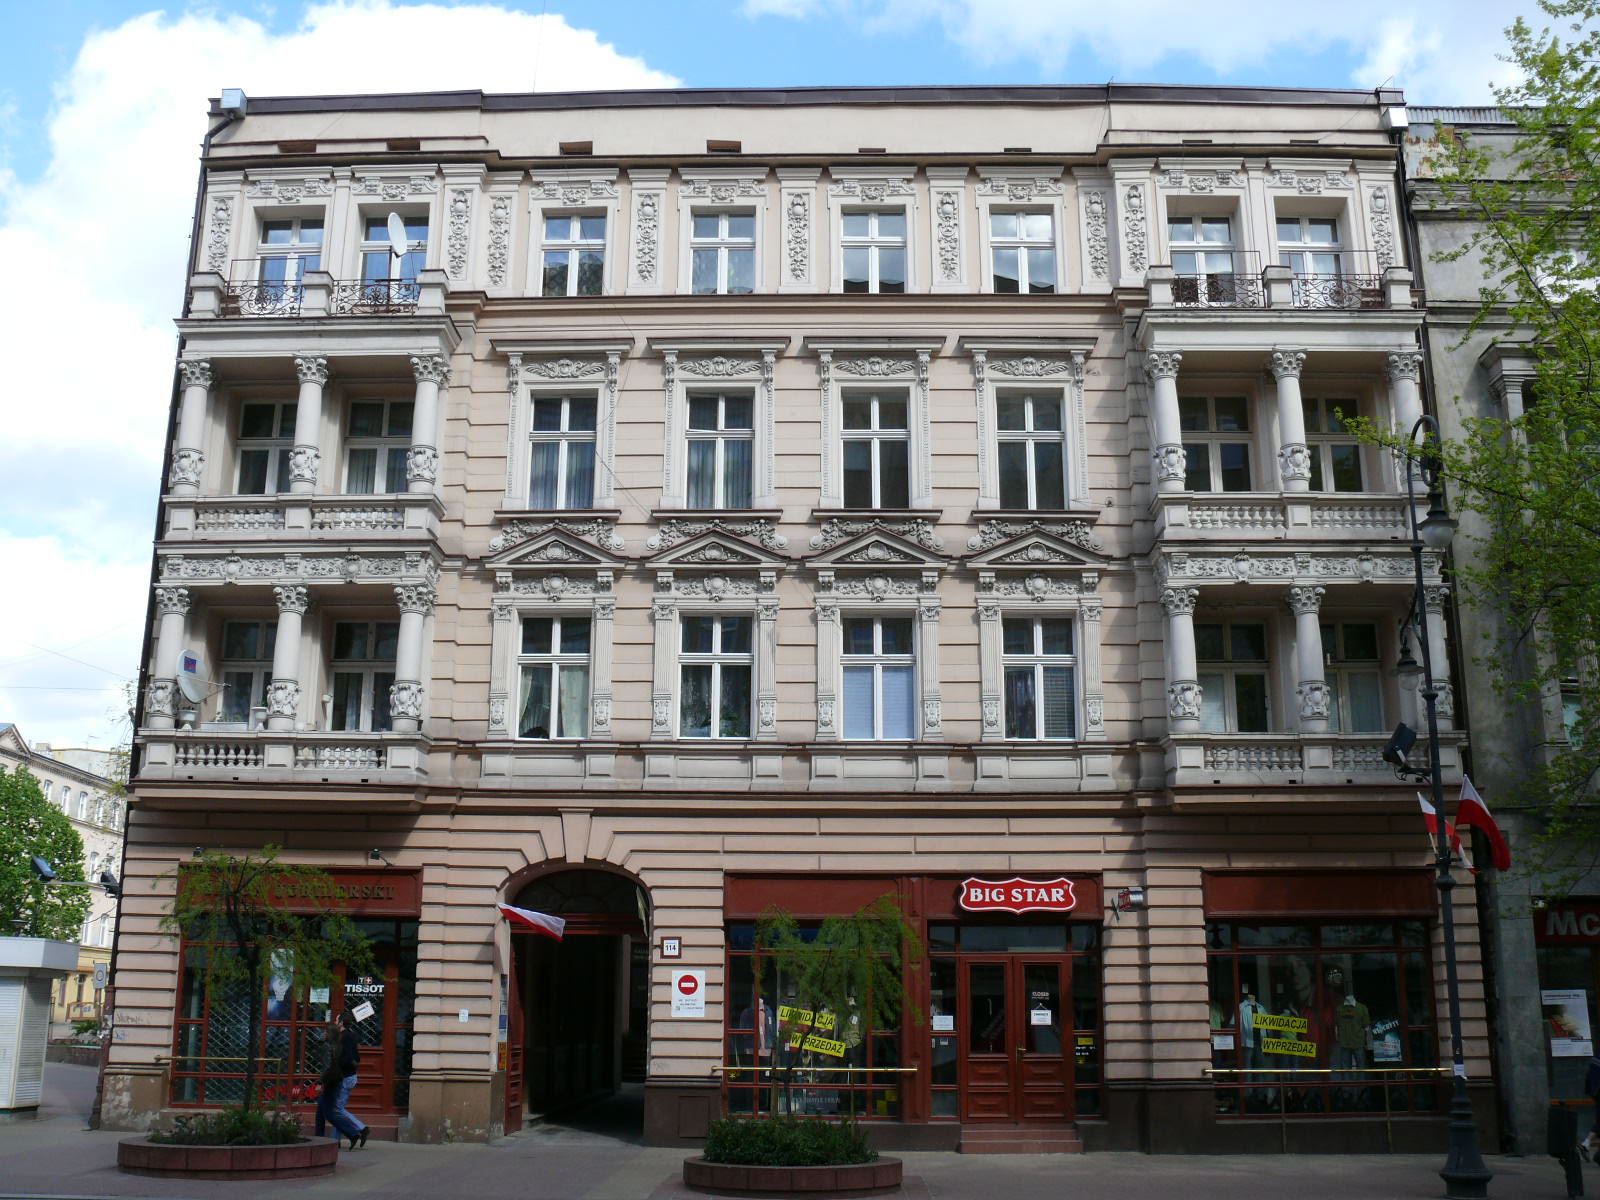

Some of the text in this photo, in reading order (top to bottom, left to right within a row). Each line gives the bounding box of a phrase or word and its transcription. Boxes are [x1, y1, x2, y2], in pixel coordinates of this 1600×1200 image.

[970, 888, 1064, 902] BIG STAR
[665, 944, 677, 952] 114
[344, 984, 384, 993] TISSOT
[780, 1008, 834, 1026] LIKIDCJA
[1254, 1016, 1307, 1030] LIKWIDACJA
